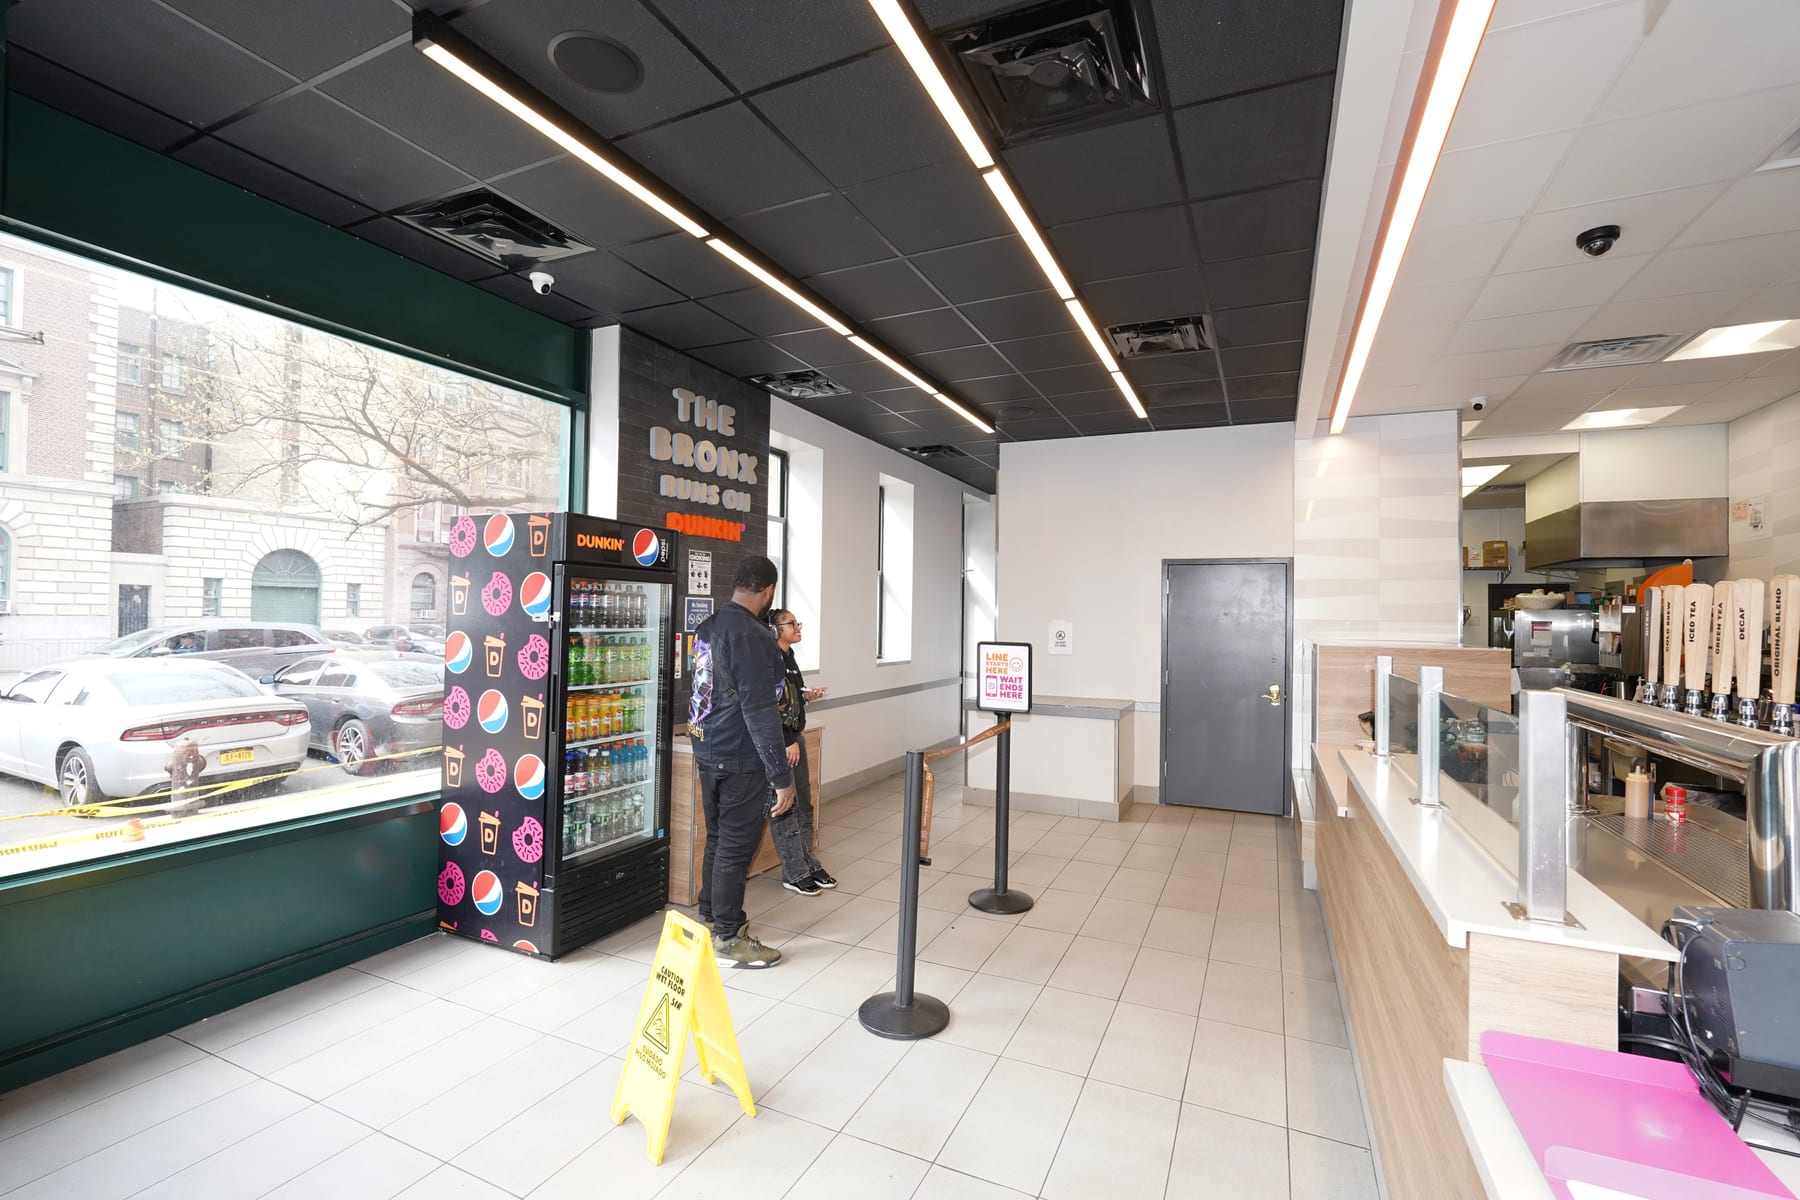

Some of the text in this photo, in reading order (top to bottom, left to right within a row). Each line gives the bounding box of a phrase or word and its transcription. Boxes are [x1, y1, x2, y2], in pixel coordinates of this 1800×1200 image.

[672, 387, 736, 437] THE
[649, 426, 758, 485] BRONX
[660, 474, 752, 513] RUNS ON
[666, 511, 746, 542] DUNKIN'
[576, 533, 625, 551] DUNKIN'
[986, 653, 1009, 662] LINE
[986, 667, 1009, 675] HERE
[1000, 675, 1023, 684] WAIT
[1000, 684, 1023, 692] ENDS
[1000, 691, 1023, 699] HERE
[656, 971, 686, 997] WET FLOOR
[661, 965, 684, 986] CAUTION
[635, 1048, 666, 1079] PISO MOJADO
[642, 1045, 662, 1066] CUIDADO
